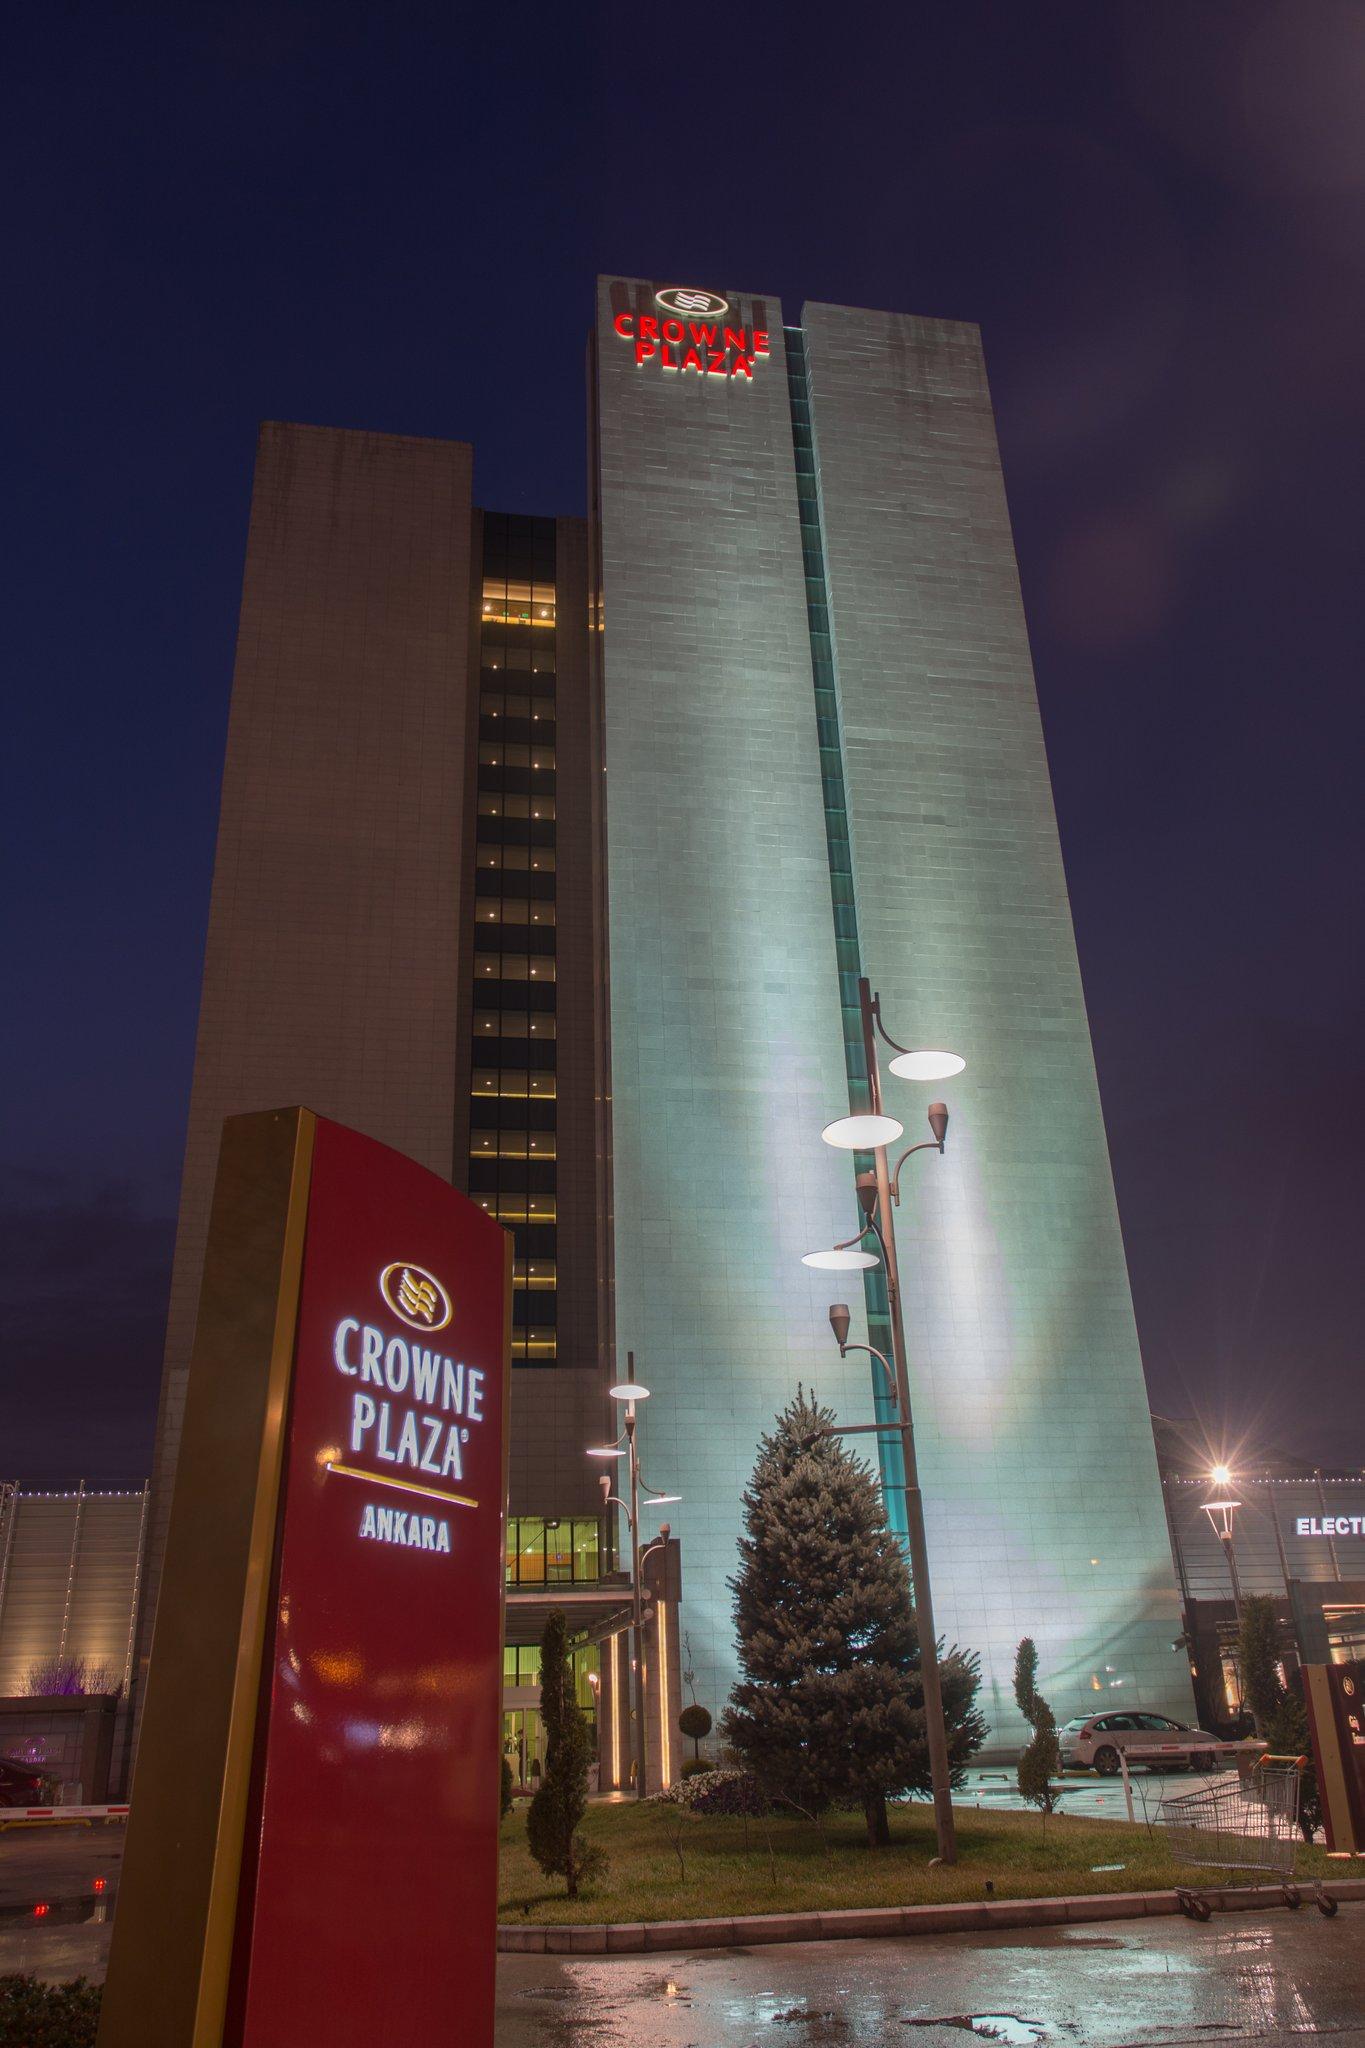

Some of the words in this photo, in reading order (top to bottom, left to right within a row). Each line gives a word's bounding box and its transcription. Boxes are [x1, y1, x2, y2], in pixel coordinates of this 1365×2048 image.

[613, 313, 770, 356] CROWNE
[635, 342, 754, 380] PLAZA
[334, 1317, 484, 1422] CROWNE
[359, 1504, 450, 1553] ANKARA
[1296, 1516, 1365, 1535] ELECT
